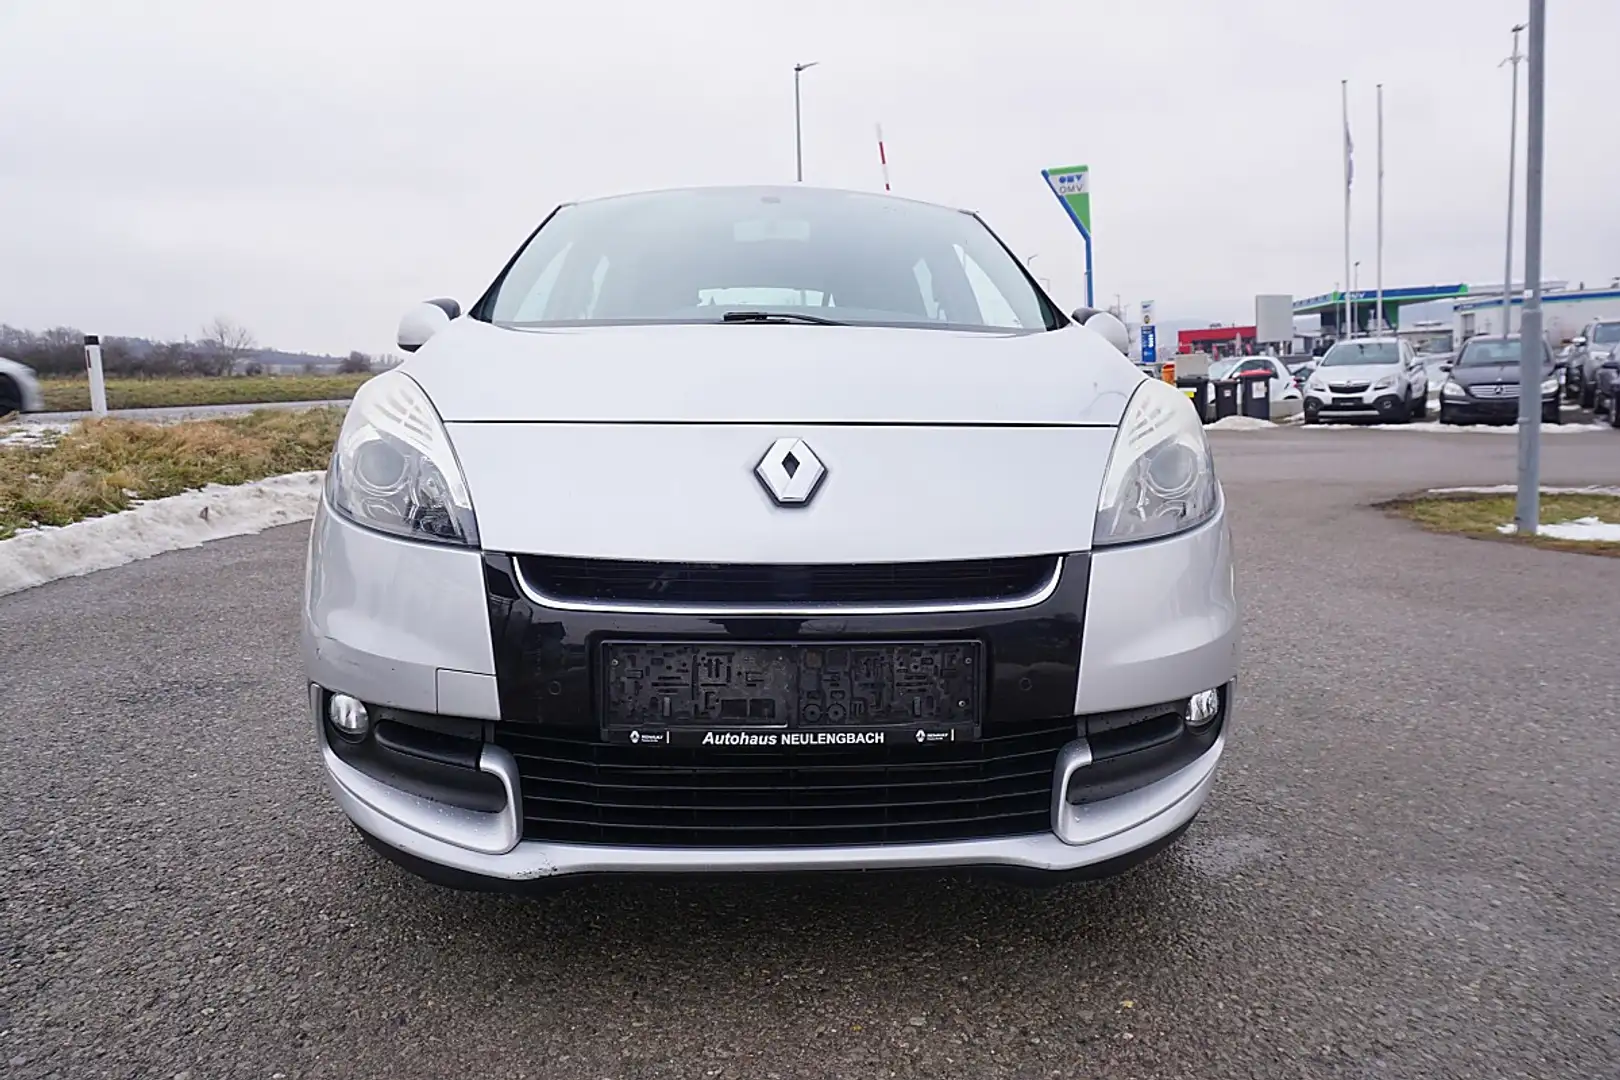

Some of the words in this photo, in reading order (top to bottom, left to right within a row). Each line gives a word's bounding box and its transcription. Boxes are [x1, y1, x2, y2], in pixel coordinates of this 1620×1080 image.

[1060, 184, 1083, 194] OMV
[702, 732, 777, 745] Autohaus
[781, 732, 885, 745] NEULENGBACH
